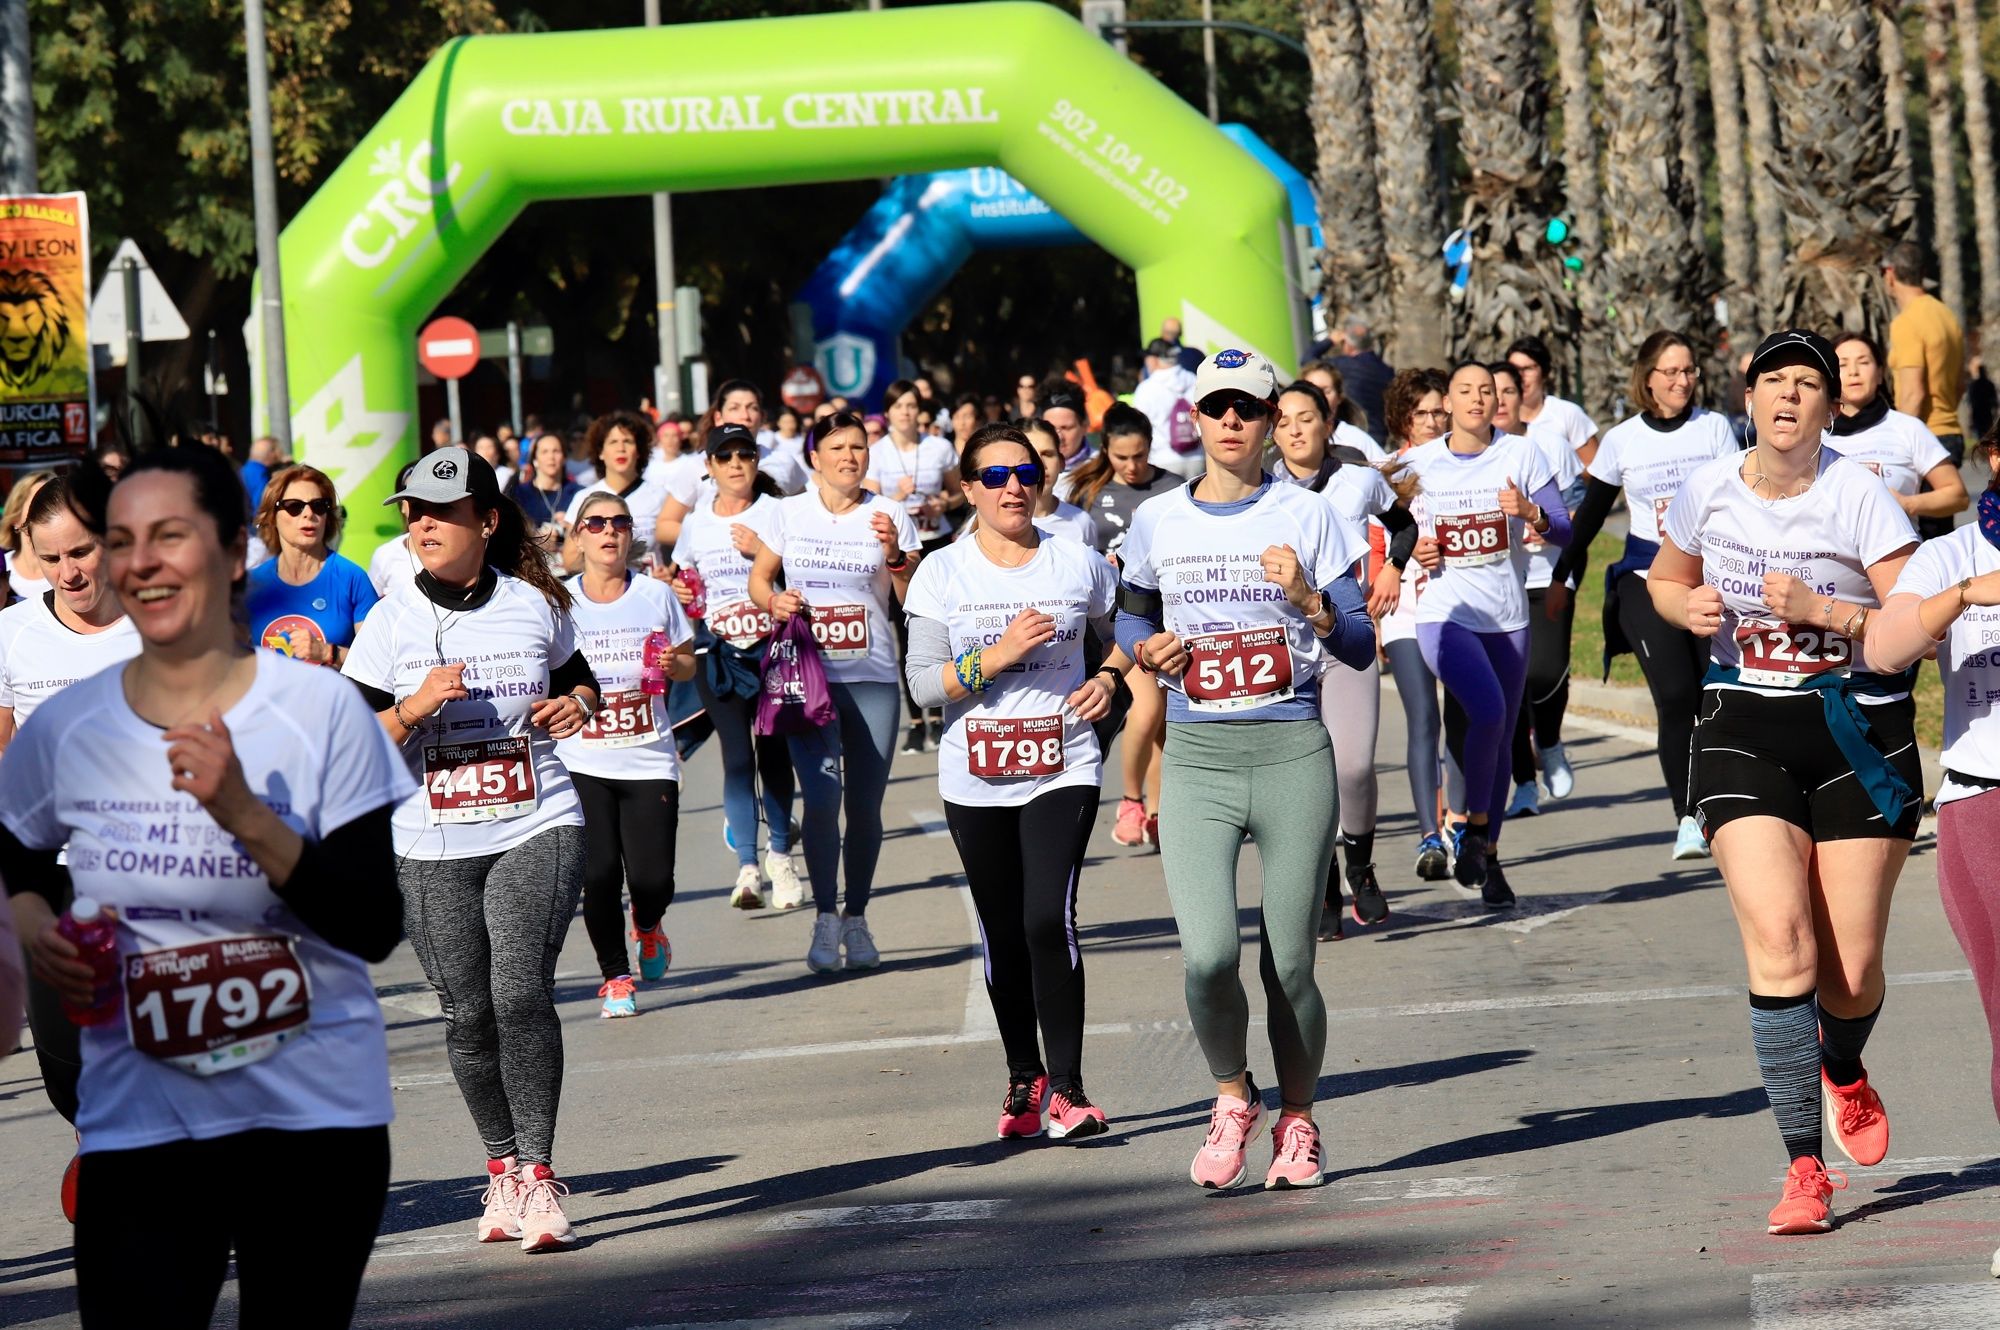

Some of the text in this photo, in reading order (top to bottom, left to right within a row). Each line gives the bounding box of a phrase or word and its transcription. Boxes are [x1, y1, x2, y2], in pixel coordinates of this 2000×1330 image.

[501, 88, 999, 137] CAJA RURAL CENTRAL
[1049, 98, 1189, 210] 902 104 102
[342, 139, 462, 269] CRC
[23, 203, 77, 228] ALASKA
[65, 408, 85, 436] 12
[15, 430, 62, 448] FICA
[1459, 496, 1473, 508] MÍ
[1475, 512, 1504, 521] MURCIA
[797, 536, 823, 544] CARRERA
[1445, 527, 1498, 552] 308
[1707, 536, 1720, 547] VIII
[1722, 540, 1755, 557] CARRERA
[1756, 549, 1768, 558] DE
[1769, 550, 1781, 559] LA
[1783, 550, 1812, 560] MUJER
[814, 545, 830, 557] MÍ
[794, 558, 878, 574] COMPAÑERAS
[1161, 558, 1174, 567] VIII
[1175, 555, 1213, 565] CARRERA
[1242, 554, 1261, 562] MUJ
[1719, 555, 1745, 575] POR
[1747, 558, 1767, 577] MÍ
[1177, 571, 1204, 585] POR
[1206, 563, 1227, 582] MÍ
[1230, 569, 1241, 582] Y
[959, 604, 972, 613] VIII
[974, 602, 1011, 611] CARRERA
[1013, 601, 1024, 609] DE
[1026, 600, 1037, 609] LA
[1038, 599, 1063, 608] MUJER
[975, 615, 1002, 630] POR
[811, 620, 865, 644] 090
[1241, 631, 1281, 643] MURCIA
[1982, 630, 2000, 645] PO
[595, 635, 610, 649] MÍ
[1200, 639, 1234, 656] mujer
[1743, 631, 1849, 663] 1225
[405, 660, 422, 671] VIII
[424, 656, 464, 668] CARRERA
[466, 656, 479, 664] DE
[480, 654, 491, 663] LA
[493, 651, 521, 661] MUJER
[460, 664, 526, 681] MÍ Y POR
[1199, 653, 1277, 691] 512
[27, 680, 44, 690] VIII
[1230, 689, 1249, 697] MATI
[984, 723, 1016, 738] mujer
[1022, 717, 1060, 729] MURCIA
[427, 745, 479, 764] 8 carrera mujer
[487, 740, 526, 752] MURCIA
[971, 738, 1062, 768] 1798
[430, 761, 528, 799] 4451
[100, 799, 162, 814] CARRERA
[164, 801, 180, 814] DE
[458, 799, 477, 807] JOSE
[148, 814, 180, 845] MÍ
[184, 825, 203, 848] Y
[105, 848, 263, 879] COMPAÑER
[220, 939, 283, 959] MURCIA
[130, 957, 147, 980] 8
[154, 952, 210, 983] mujer
[136, 968, 304, 1043] 1792
